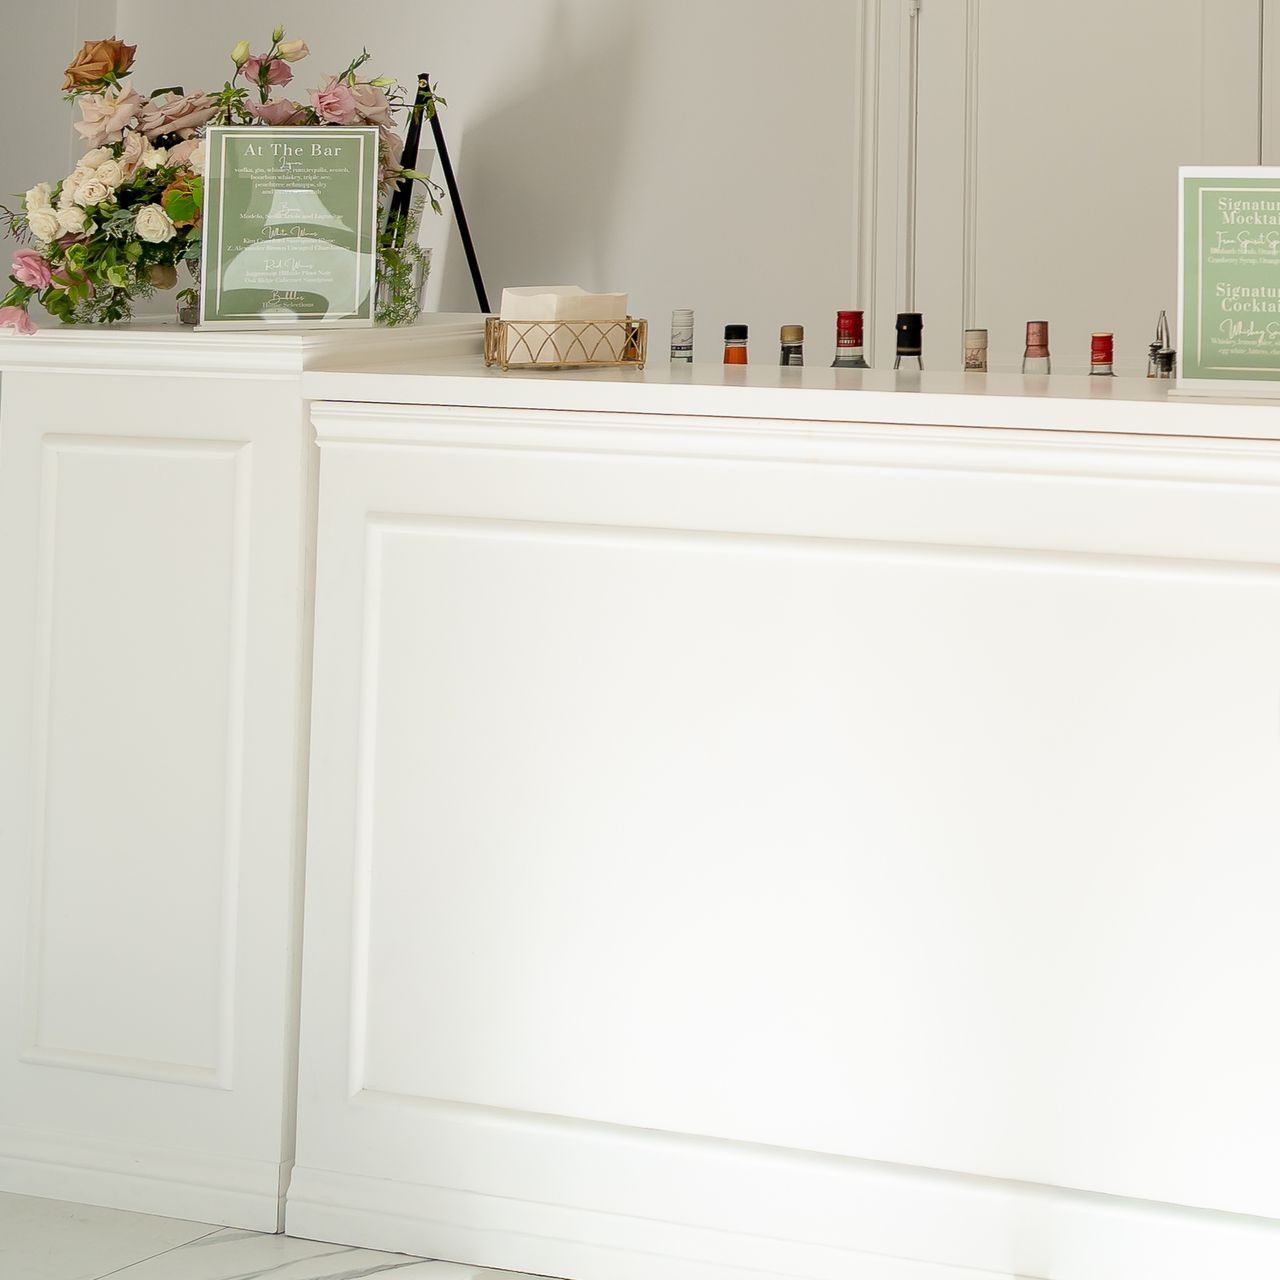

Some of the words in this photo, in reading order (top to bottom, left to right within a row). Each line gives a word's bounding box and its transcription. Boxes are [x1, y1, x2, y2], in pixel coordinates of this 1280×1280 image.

[243, 143, 263, 156] At
[270, 143, 304, 156] The
[311, 144, 342, 157] Bar
